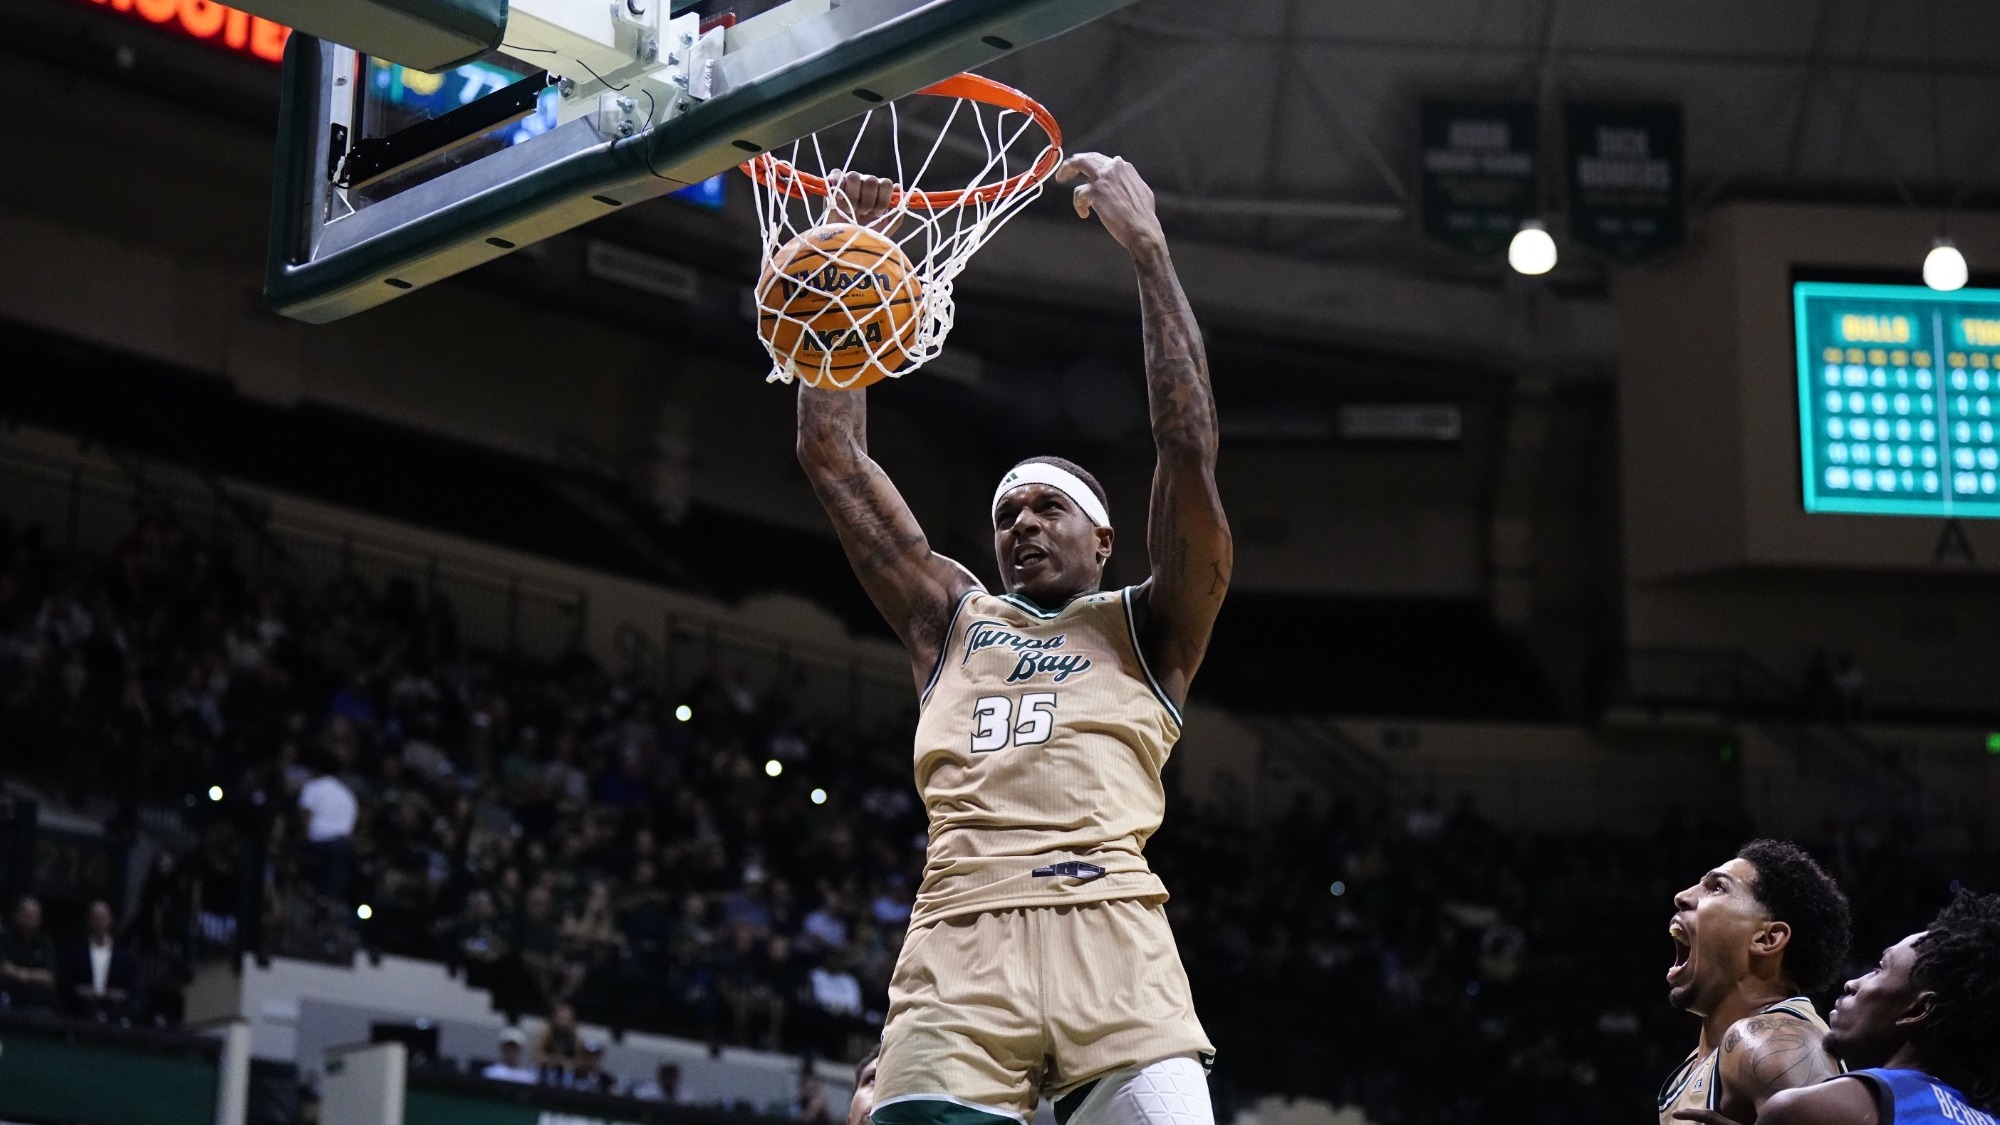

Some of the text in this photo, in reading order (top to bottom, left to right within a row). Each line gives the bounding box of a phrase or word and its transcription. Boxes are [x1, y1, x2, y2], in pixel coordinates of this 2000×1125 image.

[783, 264, 891, 301] Wilson
[803, 321, 883, 352] NCAA
[961, 620, 1066, 667] Tampa
[1004, 650, 1092, 684] Bay
[970, 692, 1058, 753] 35
